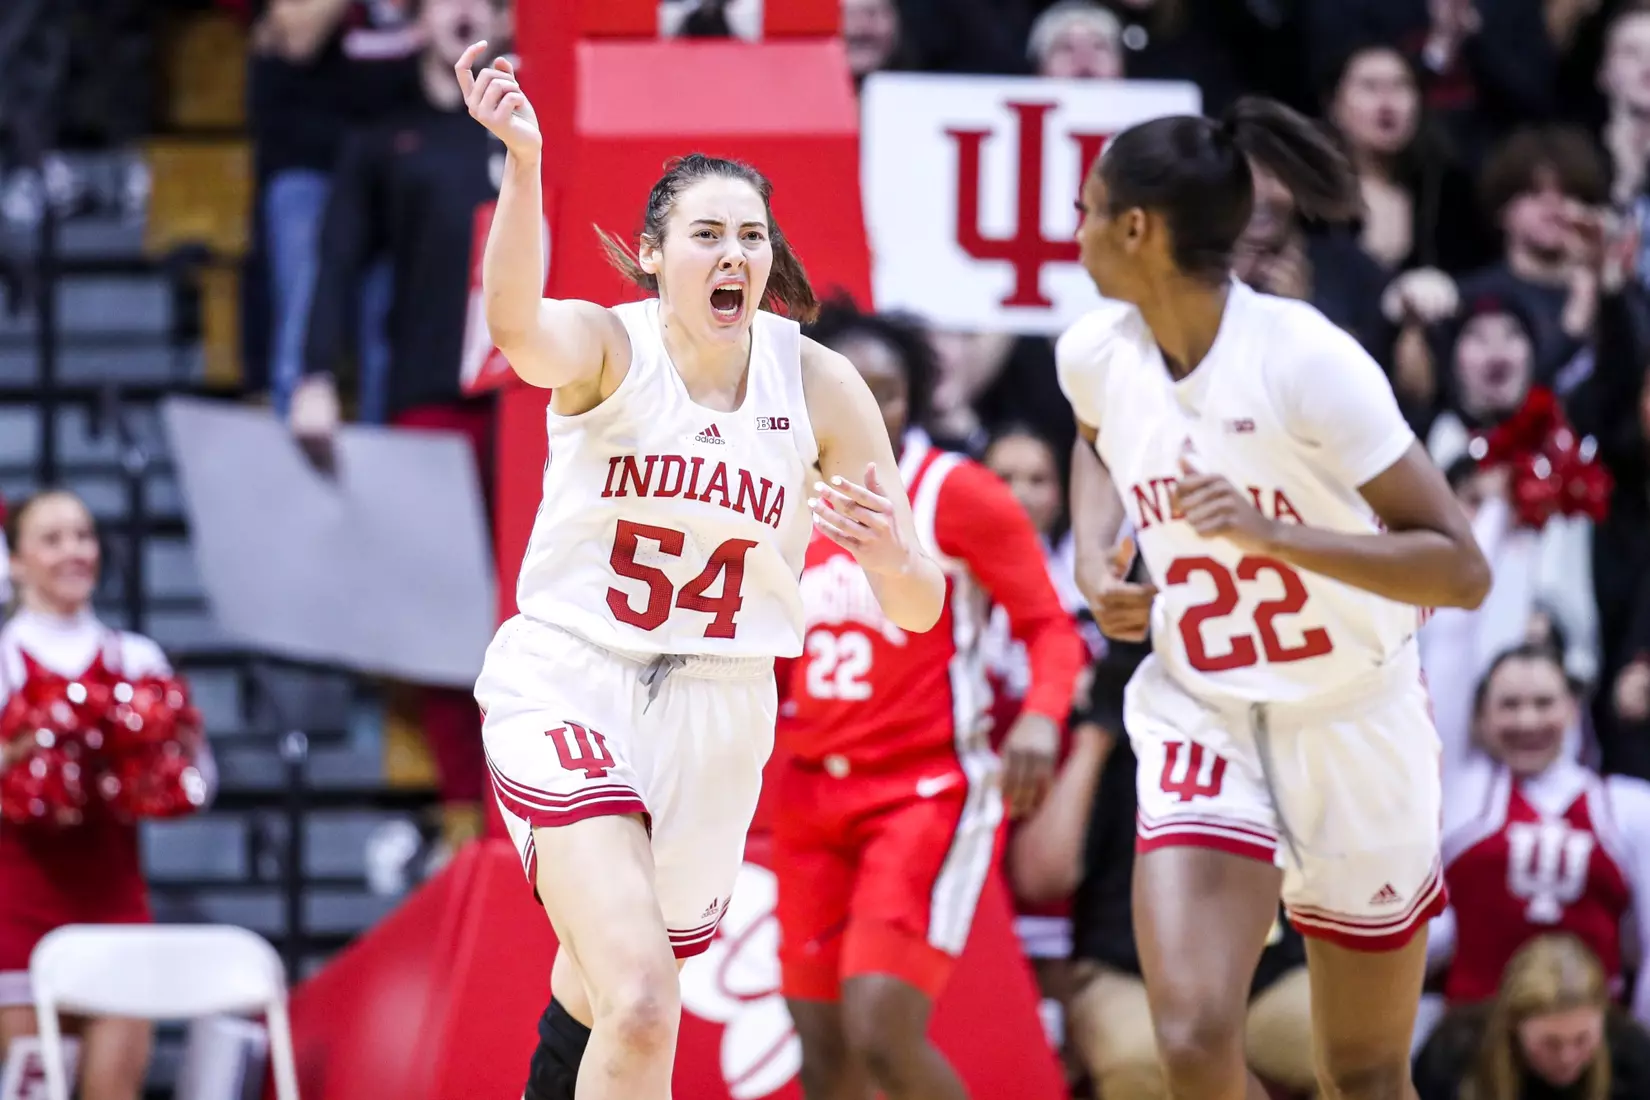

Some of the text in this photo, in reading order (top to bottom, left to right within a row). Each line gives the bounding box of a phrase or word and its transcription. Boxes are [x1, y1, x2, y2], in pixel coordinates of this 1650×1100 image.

[695, 435, 725, 445] adidas
[601, 455, 784, 528] INDIANA
[606, 519, 759, 639] 54
[1166, 555, 1333, 672] 22
[806, 630, 873, 700] 22
